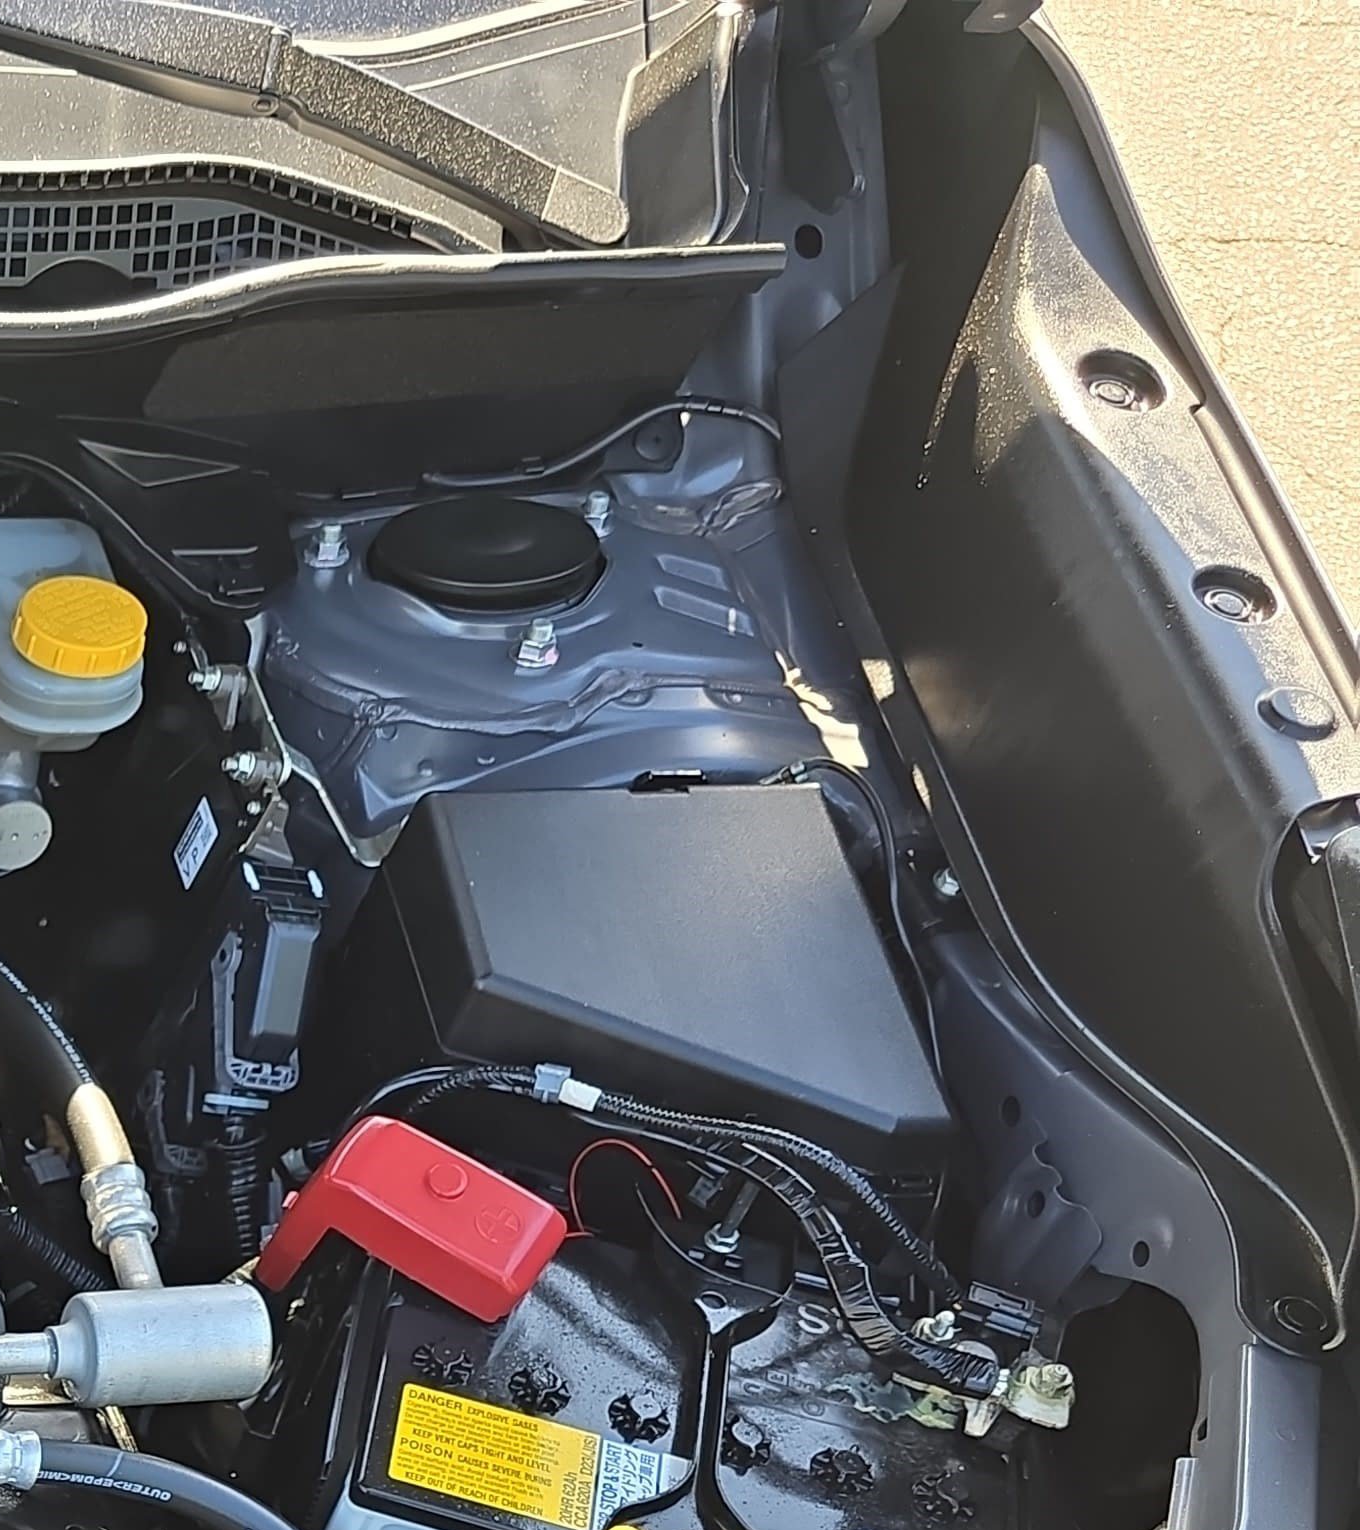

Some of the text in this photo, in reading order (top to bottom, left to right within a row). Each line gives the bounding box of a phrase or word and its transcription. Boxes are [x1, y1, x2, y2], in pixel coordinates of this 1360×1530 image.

[408, 1388, 462, 1411] DANGER
[399, 1436, 453, 1460] POISON
[412, 1426, 432, 1439] KEEP
[434, 1433, 455, 1445] VENT
[506, 1453, 524, 1465] AND
[604, 1443, 622, 1472] START
[404, 1469, 425, 1483] KEEP
[426, 1476, 443, 1488] OUT
[445, 1481, 456, 1492] OF
[487, 1493, 498, 1503] OF
[604, 1472, 619, 1482] &
[559, 1471, 578, 1524] 20HR 62Ah
[599, 1483, 618, 1515] STOP
[574, 1502, 589, 1528] CCA
